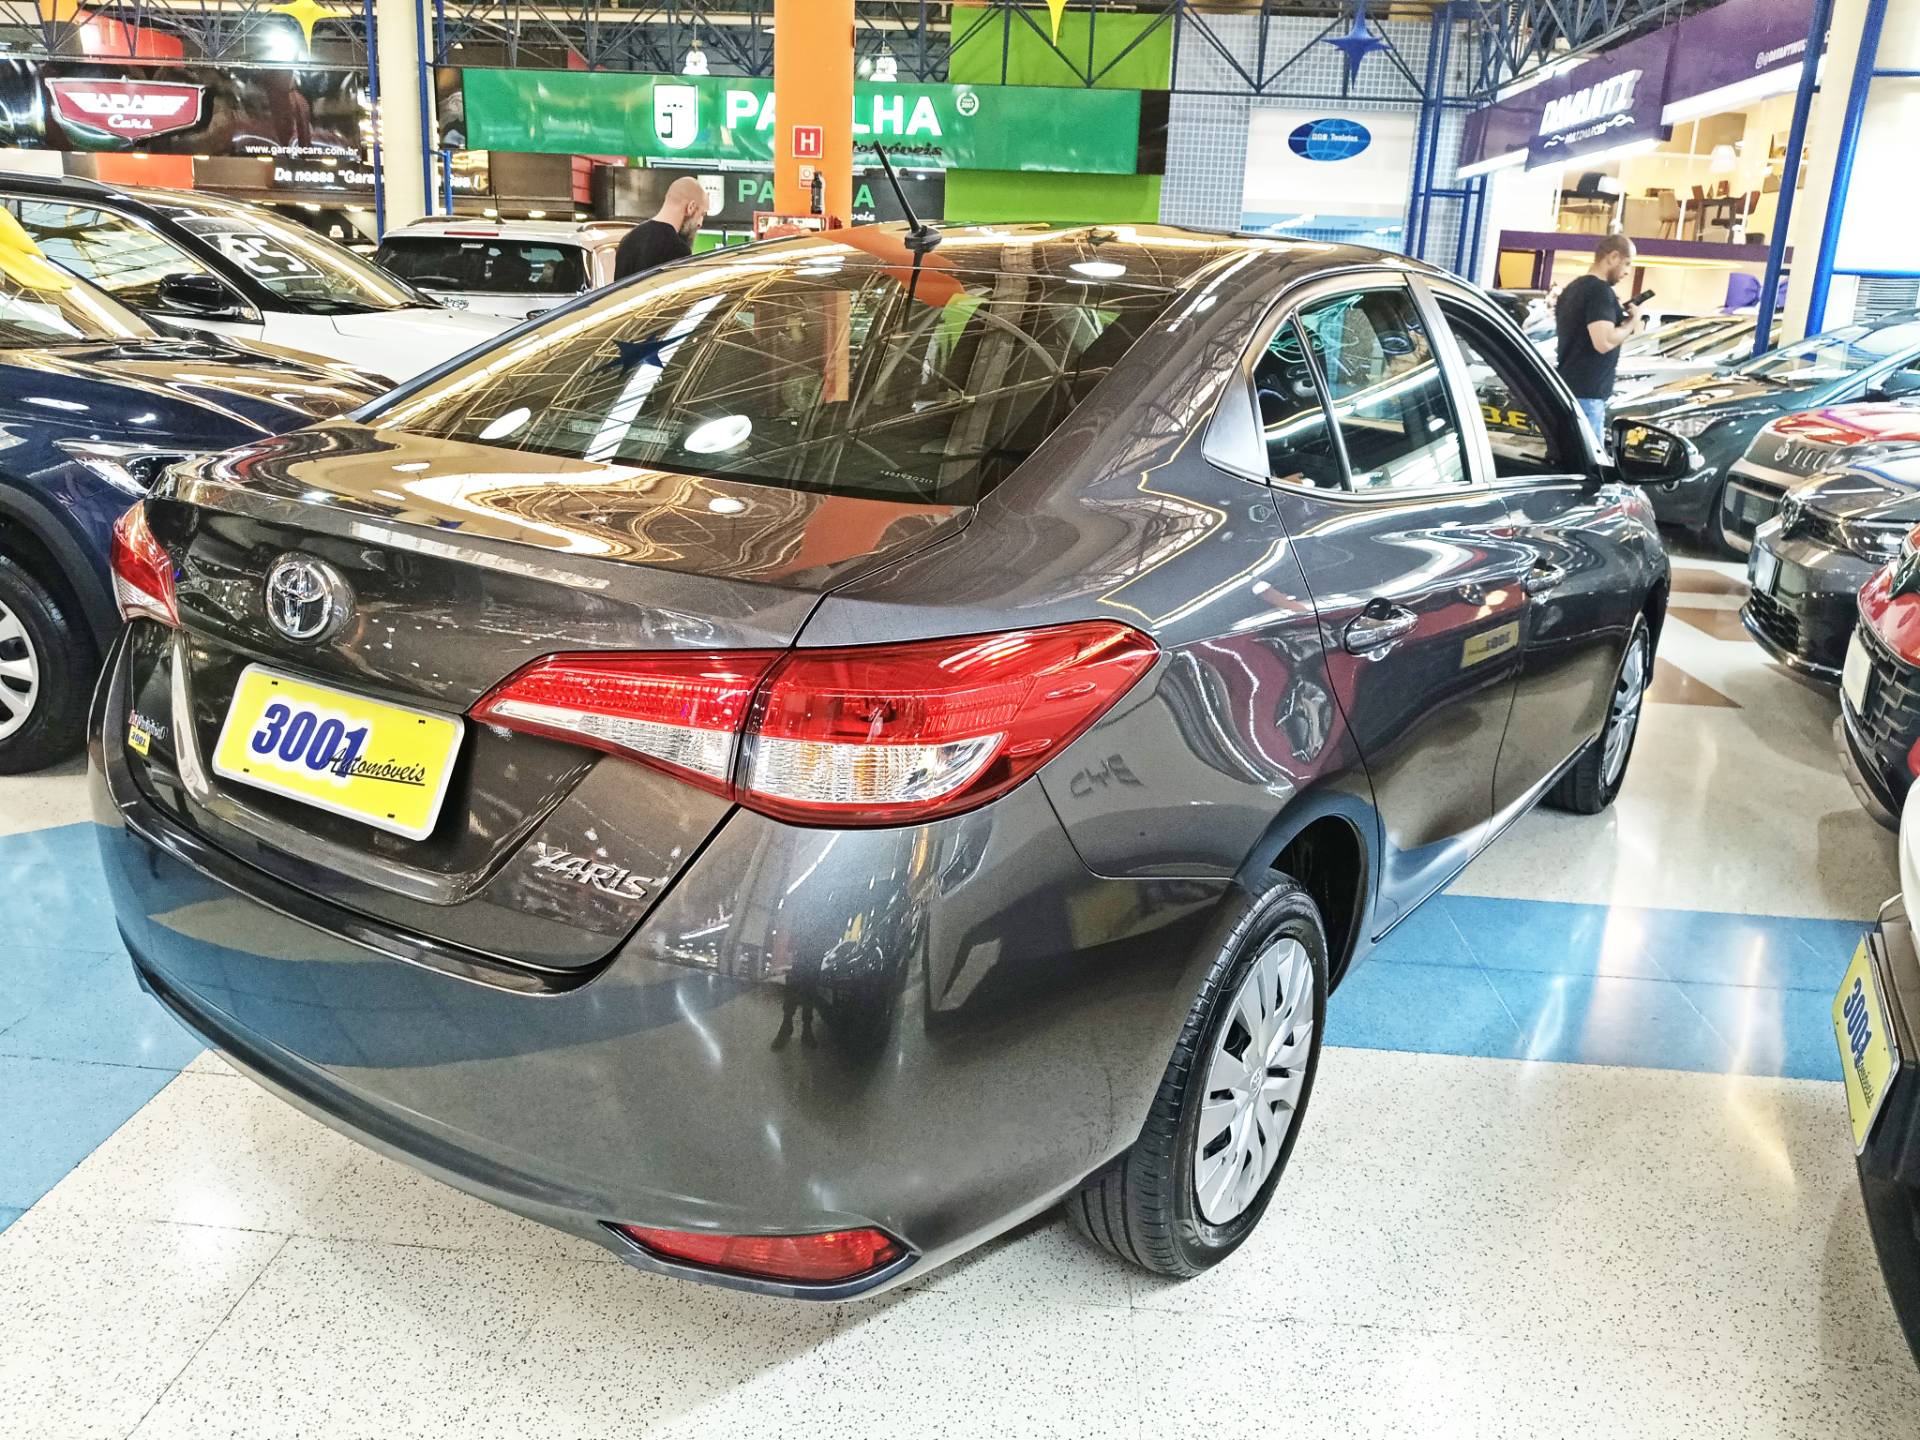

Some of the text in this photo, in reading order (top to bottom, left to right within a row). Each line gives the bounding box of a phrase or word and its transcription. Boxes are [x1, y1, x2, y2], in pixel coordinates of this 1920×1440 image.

[107, 115, 154, 130] Cars
[245, 144, 358, 156] www.garagecars.com.br
[800, 131, 815, 152] H
[274, 167, 293, 182] Da
[295, 170, 335, 183] nossa
[252, 703, 368, 778] 3001
[328, 748, 426, 786] Automóveis
[531, 841, 654, 900] YARIS
[1843, 976, 1872, 1069] 3001
